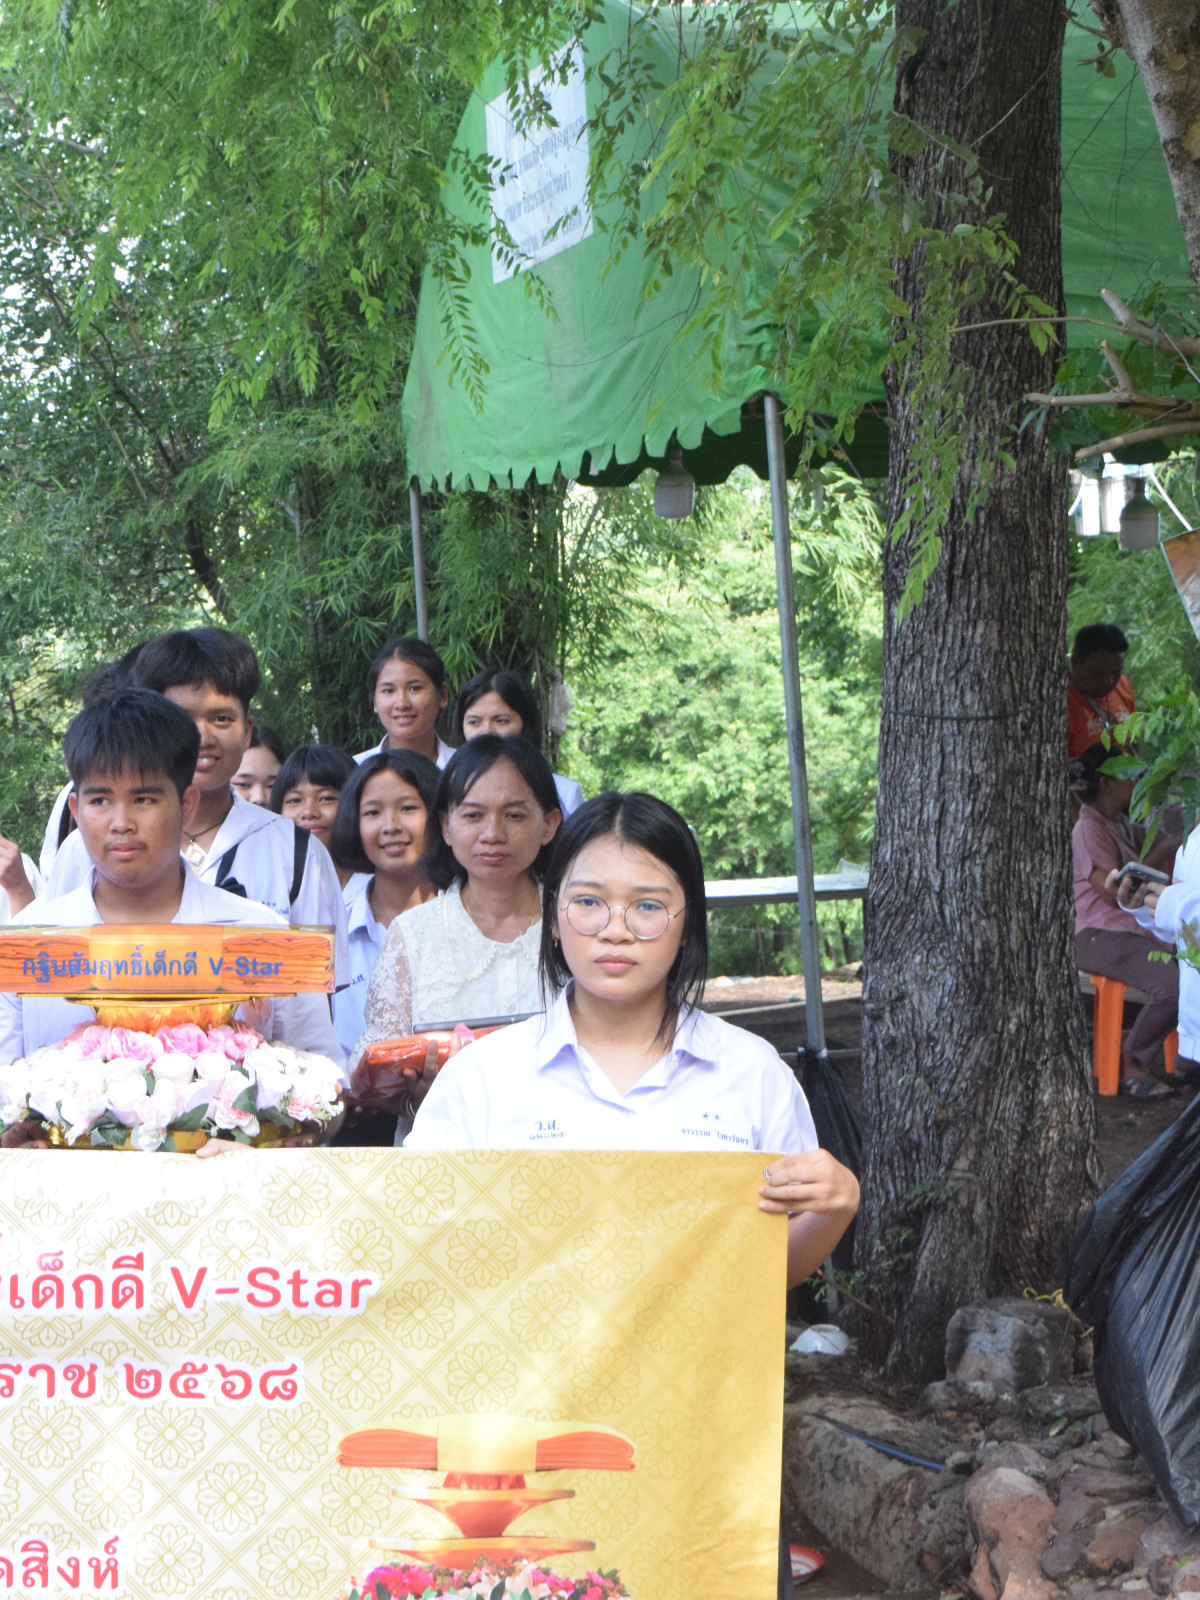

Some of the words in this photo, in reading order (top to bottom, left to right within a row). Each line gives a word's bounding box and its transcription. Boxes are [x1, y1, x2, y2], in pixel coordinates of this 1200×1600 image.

[22, 944, 197, 983] กฐินสัมฤทธิ์เด็กดี
[209, 956, 283, 976] V-Star
[169, 1266, 373, 1310] V-Star
[123, 1361, 299, 1401] ๒๕๖๘
